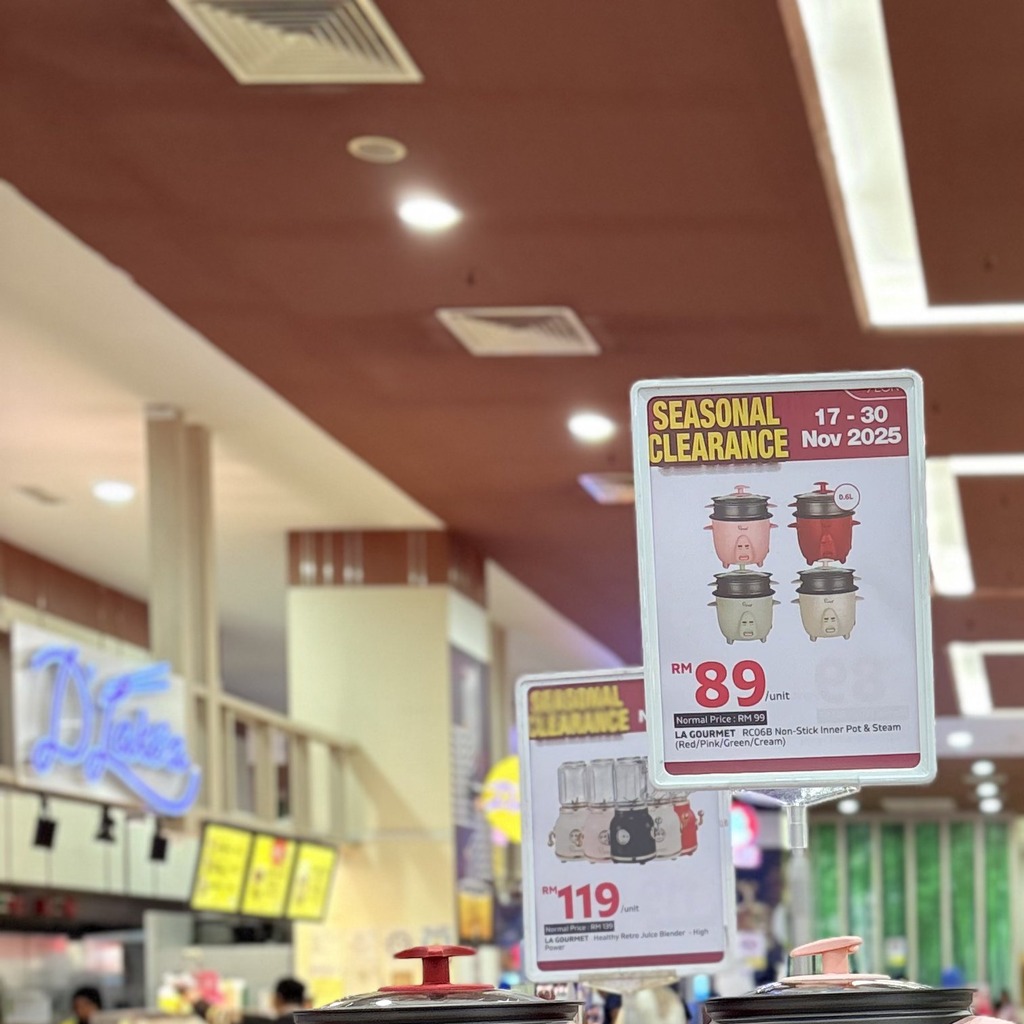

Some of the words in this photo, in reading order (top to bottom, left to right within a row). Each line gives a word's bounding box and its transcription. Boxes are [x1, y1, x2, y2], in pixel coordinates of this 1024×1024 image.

[653, 396, 780, 430] SEASONAL
[815, 408, 840, 425] 17
[860, 405, 888, 424] 30
[649, 429, 789, 464] CLEARANCE
[801, 429, 842, 448] Nov
[847, 426, 902, 446] 2025
[671, 662, 693, 675] RM
[694, 660, 767, 709] 89
[675, 730, 688, 739] LA
[690, 729, 736, 739] GOURMET
[742, 727, 773, 737] RC06B
[774, 725, 819, 736] Non-Stick
[820, 725, 844, 735] Inner
[846, 724, 862, 734] Pot
[872, 723, 901, 733] Steam
[676, 714, 708, 724] Normal
[709, 714, 731, 724] Price
[737, 713, 752, 723] RM
[754, 713, 766, 722] 99
[675, 737, 786, 750] (Red/Pink/Green/Cream)
[542, 886, 557, 895] RM
[558, 882, 620, 919] 119
